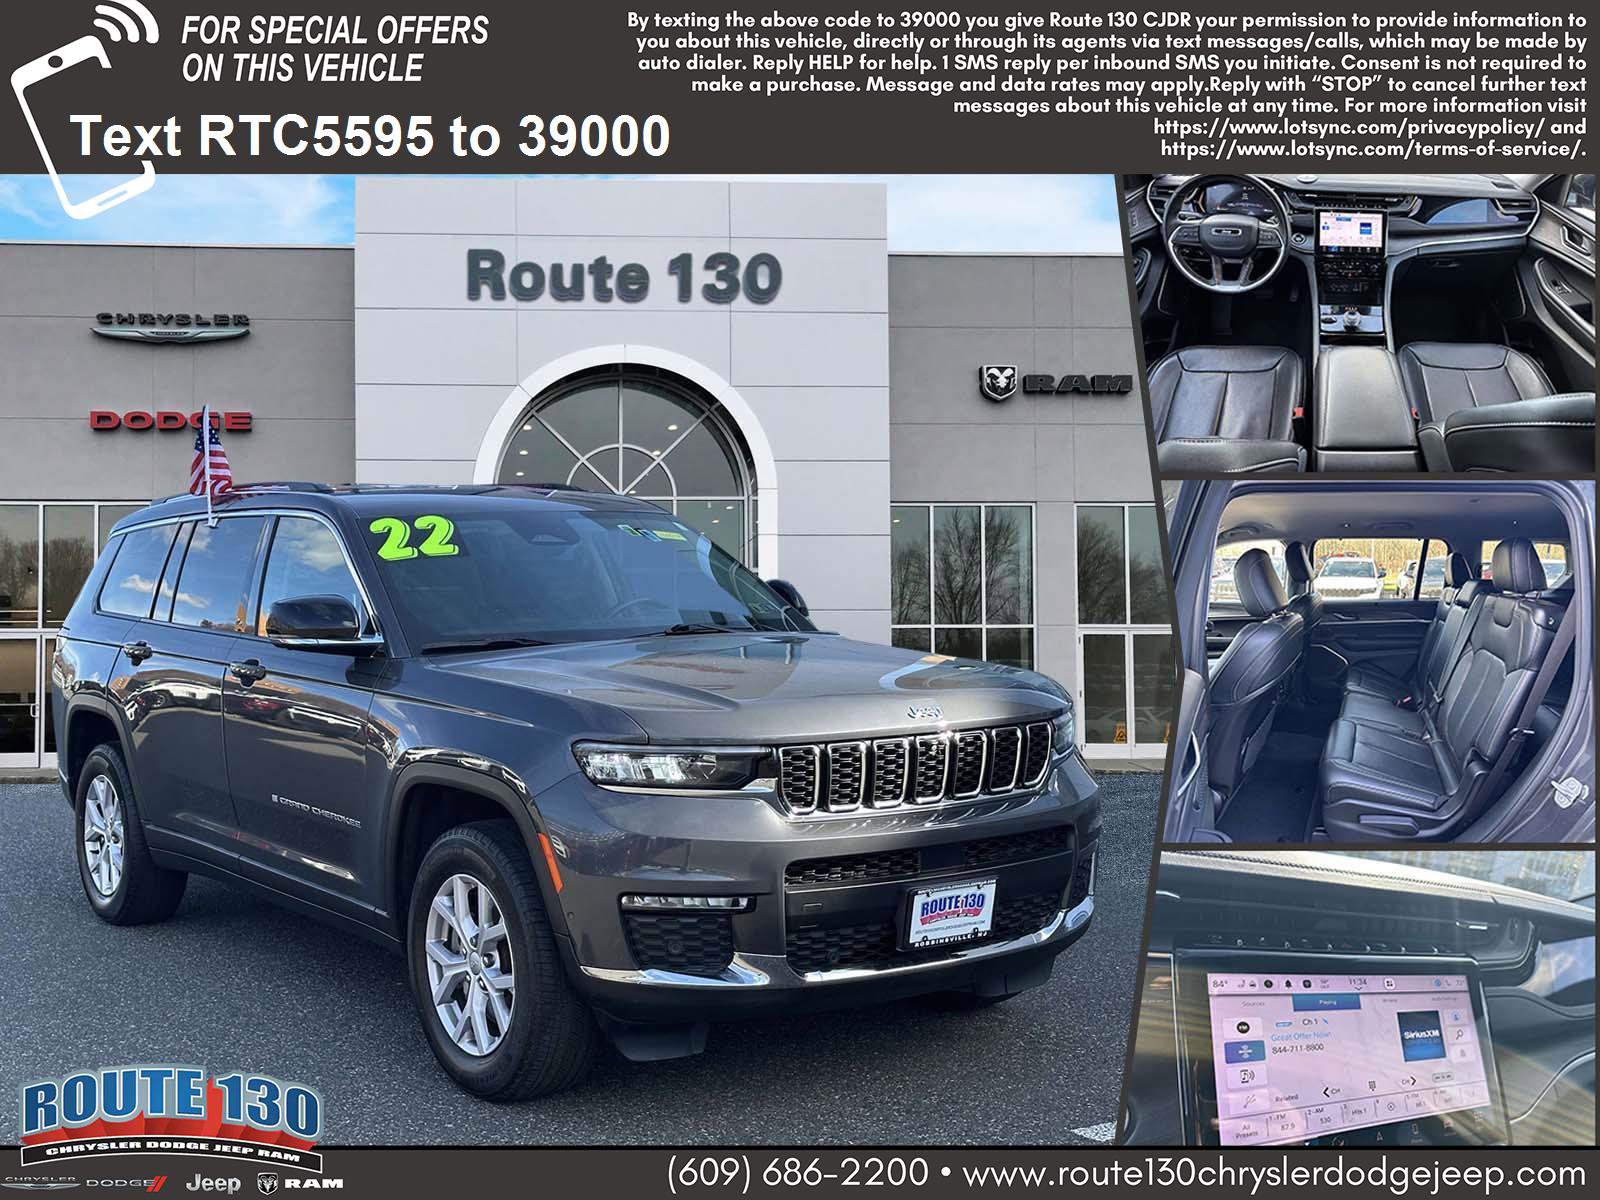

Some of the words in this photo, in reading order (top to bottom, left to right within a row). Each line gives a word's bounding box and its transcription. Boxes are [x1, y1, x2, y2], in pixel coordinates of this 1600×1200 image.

[466, 248, 650, 302] Route
[668, 251, 782, 304] 130
[96, 312, 250, 326] CHRYSLER
[1022, 374, 1133, 394] RAM
[89, 410, 253, 431] DODGE
[369, 514, 459, 561] 22
[279, 796, 310, 812] GRAND
[311, 806, 361, 829] CHEROKEE
[921, 896, 961, 916] ROUTE
[963, 893, 985, 908] 130
